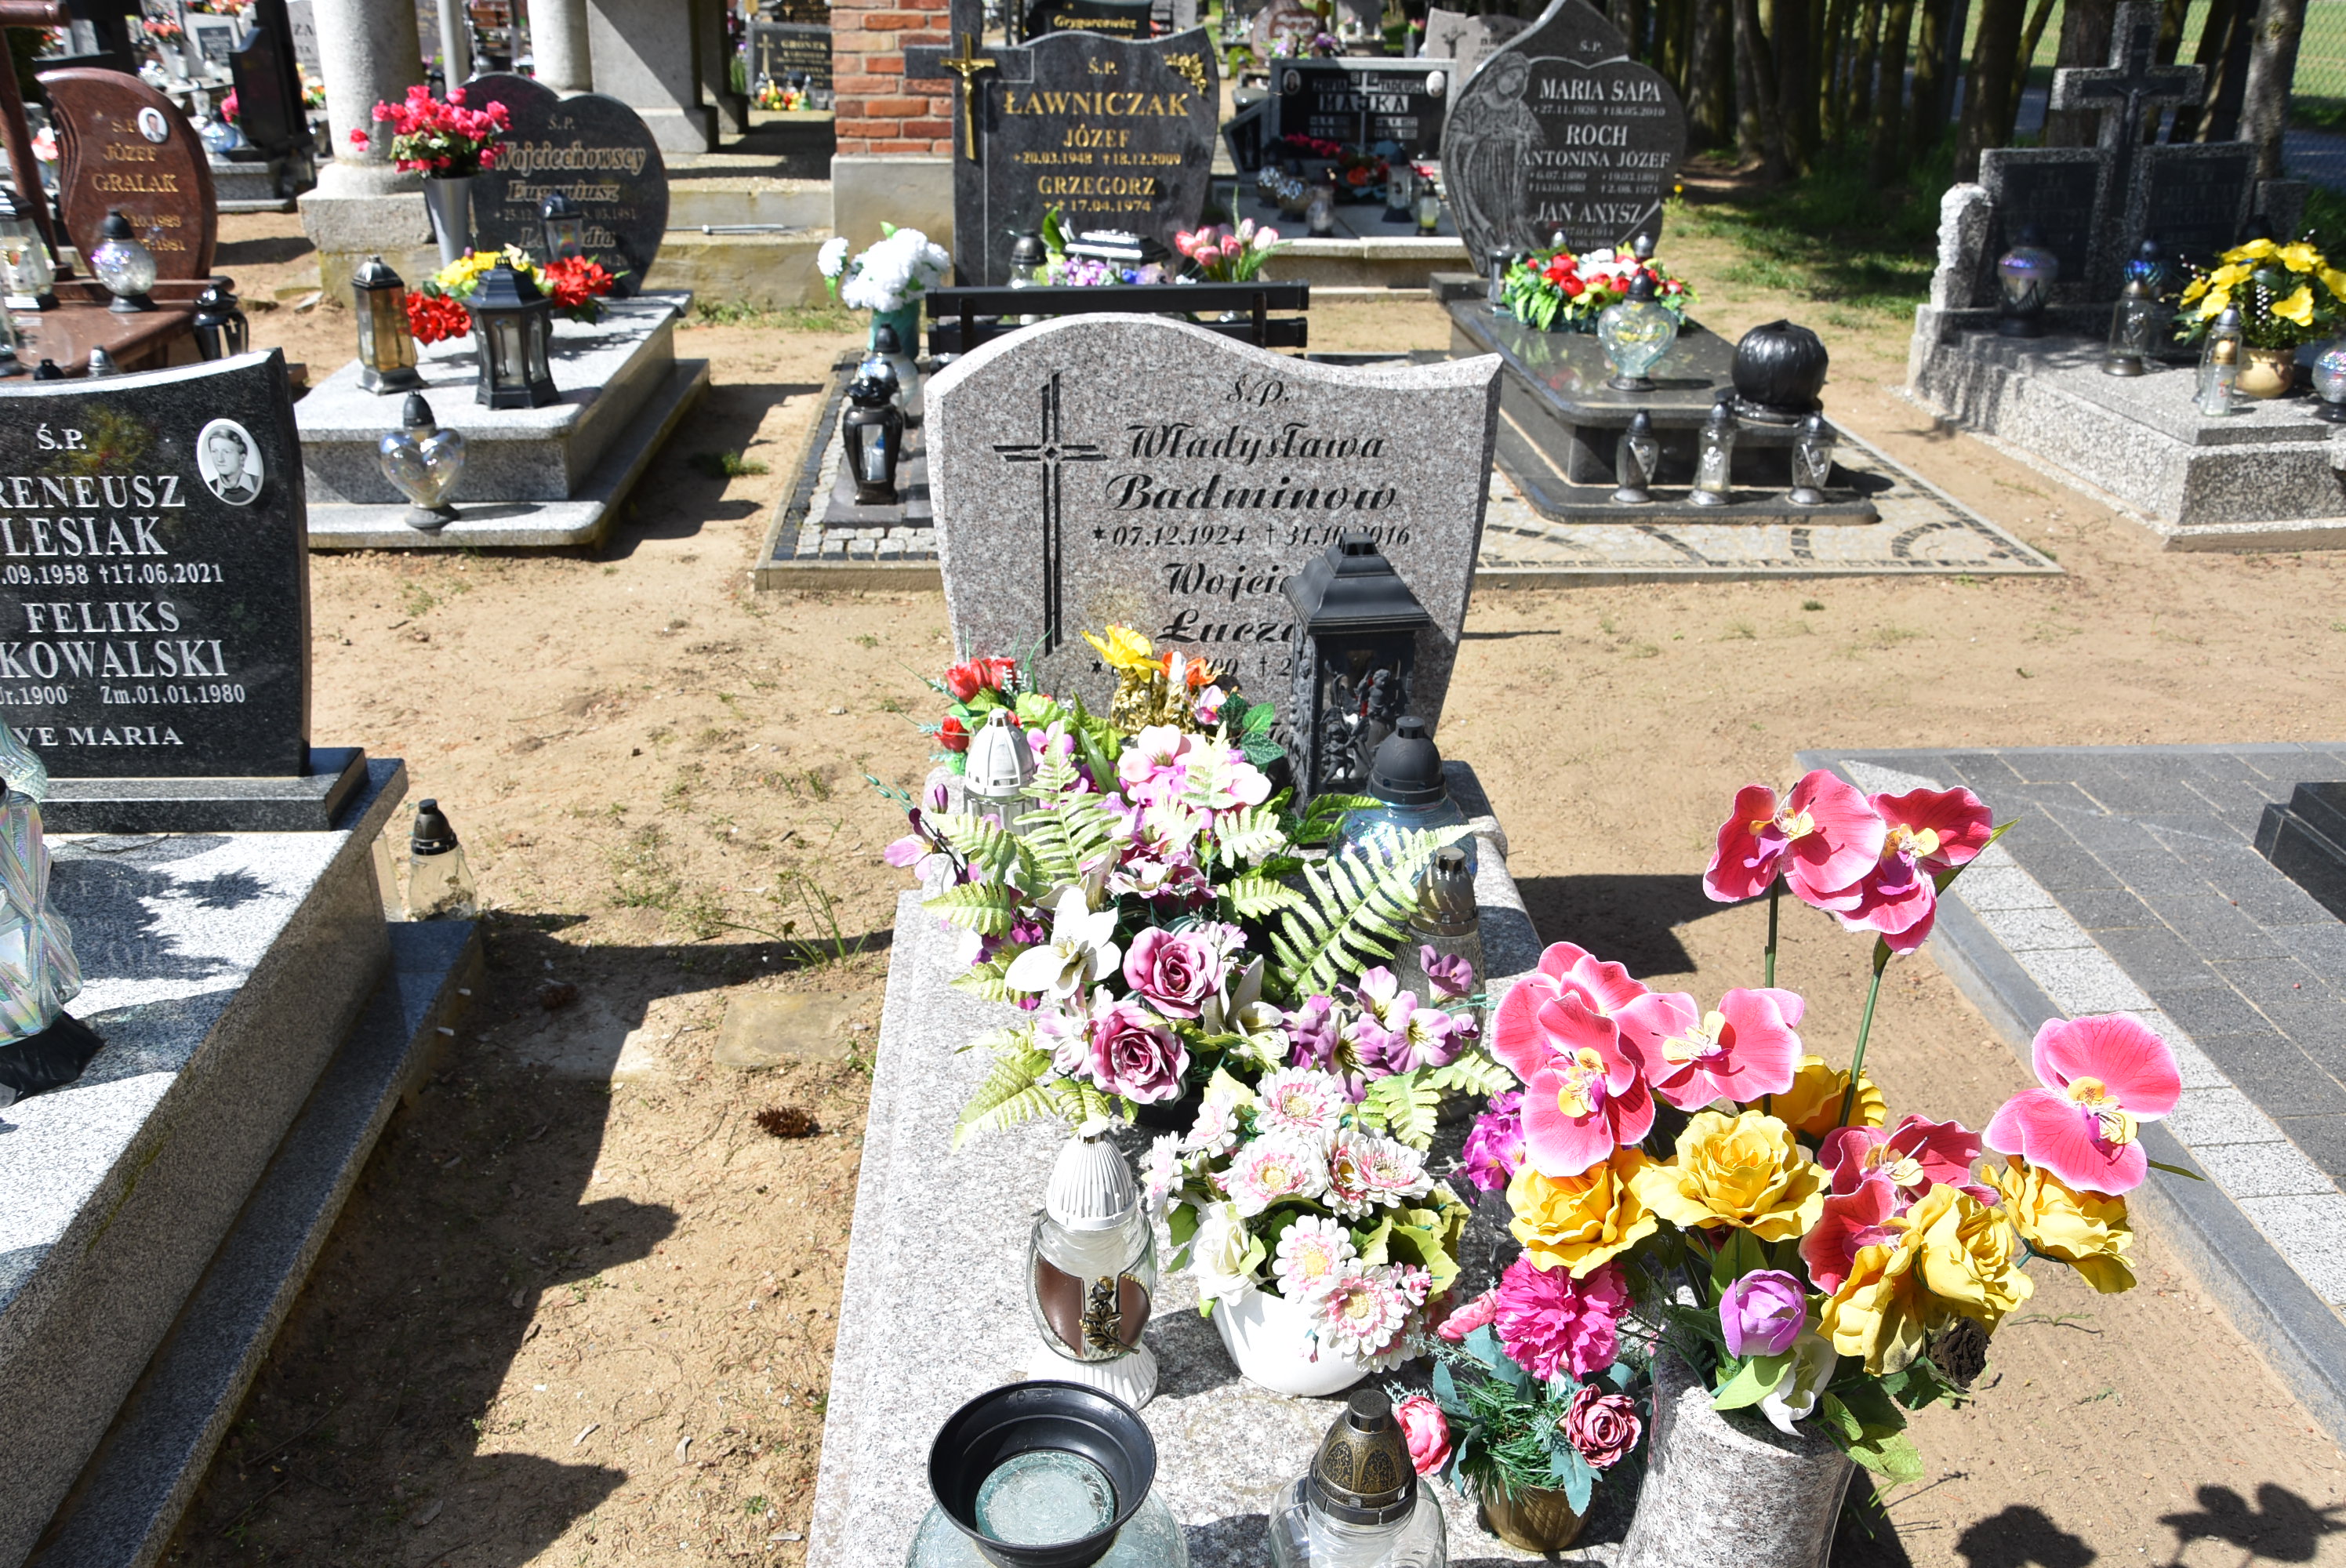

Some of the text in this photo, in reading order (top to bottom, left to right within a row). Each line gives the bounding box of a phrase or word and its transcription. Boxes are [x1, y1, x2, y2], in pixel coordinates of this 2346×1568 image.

[1539, 78, 1661, 101] MARIA SAPA
[1004, 91, 1189, 116] ŁAWNICZAK
[1322, 95, 1407, 112] MAJKA
[1063, 123, 1131, 147] JÓZEF
[1566, 124, 1629, 146] ROCH
[104, 143, 157, 162] JÓZEF
[495, 140, 646, 177] Wojciechowscy
[1113, 153, 1182, 165] 18.12.2009
[1519, 150, 1671, 169] ANTONINA JÓZEF
[91, 173, 179, 192] GRALAK
[506, 180, 620, 204] Eugniusz
[1037, 176, 1155, 195] GRZEGORZ
[1071, 200, 1151, 212] 17.04.1974
[1533, 201, 1642, 224] JAN ANYSZ
[1226, 374, 1291, 407] Ś.P.
[36, 422, 87, 450] Ś.P.
[1127, 422, 1385, 466] Władysława
[1106, 473, 1397, 511] Badminow
[0, 517, 169, 556] LESIAK
[1112, 524, 1411, 547] 07.12.1924 31.10016
[1162, 562, 1294, 602] Wojci
[21, 601, 180, 633] FELIKS
[0, 640, 229, 679] KOWALSKI
[100, 684, 245, 704] Zm.01.01.1980
[11, 726, 184, 746] VE MARIA
